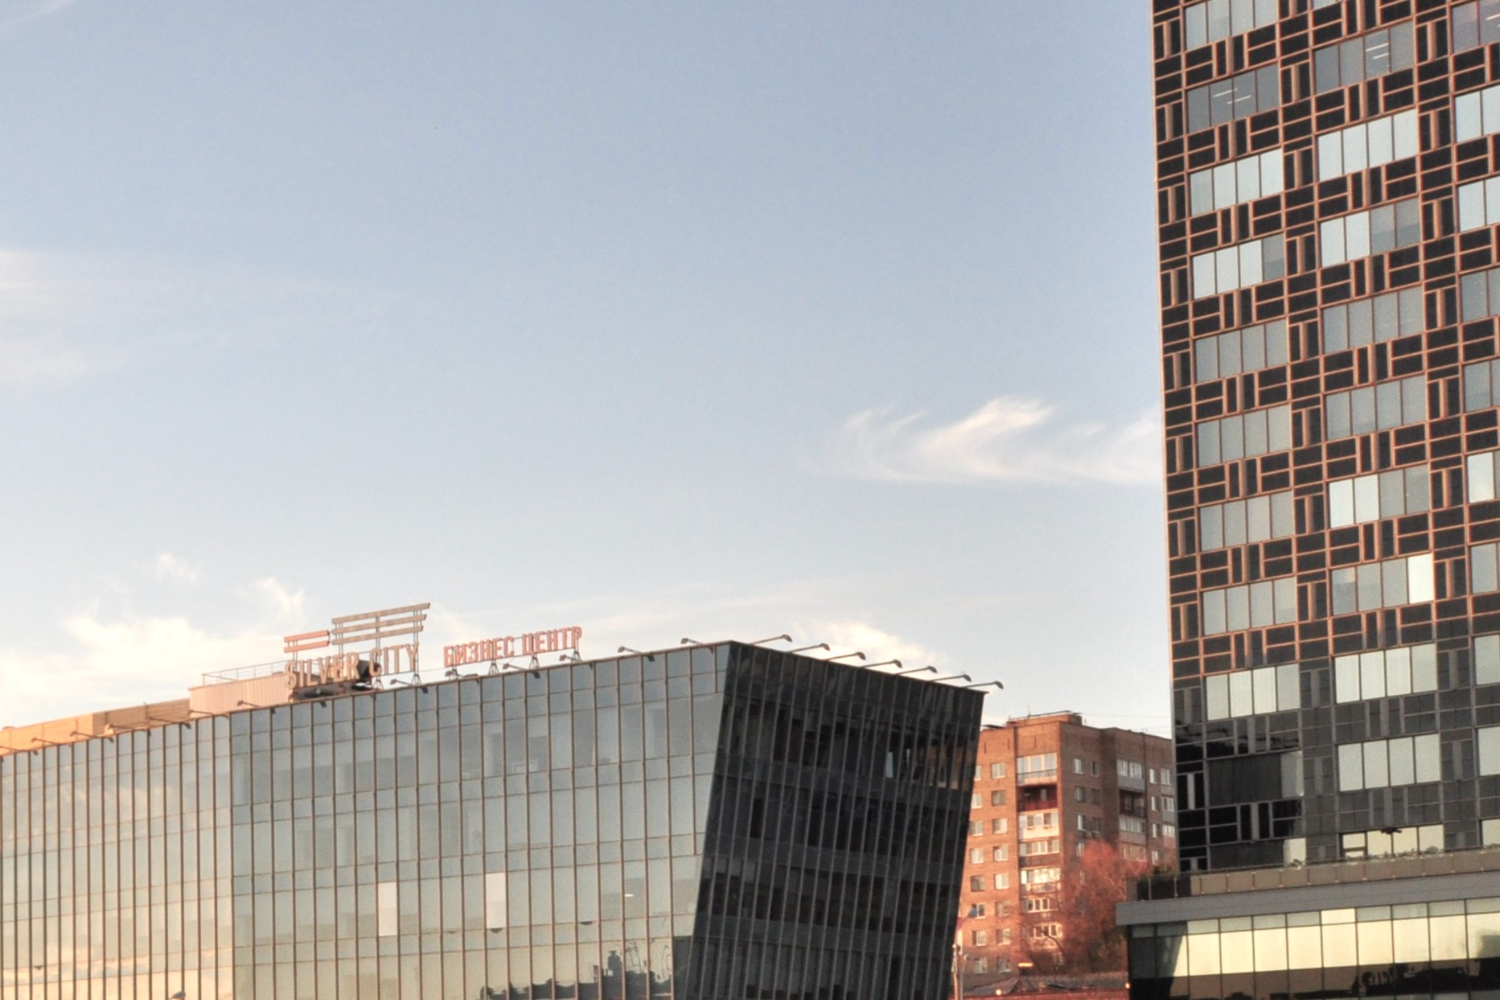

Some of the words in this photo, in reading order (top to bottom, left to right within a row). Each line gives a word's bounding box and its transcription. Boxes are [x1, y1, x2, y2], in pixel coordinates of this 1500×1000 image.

[285, 652, 361, 690] SILVER
[369, 643, 419, 677] CITY
[443, 636, 515, 667] БИЗНЕС
[522, 626, 582, 655] ЦЕНТР
